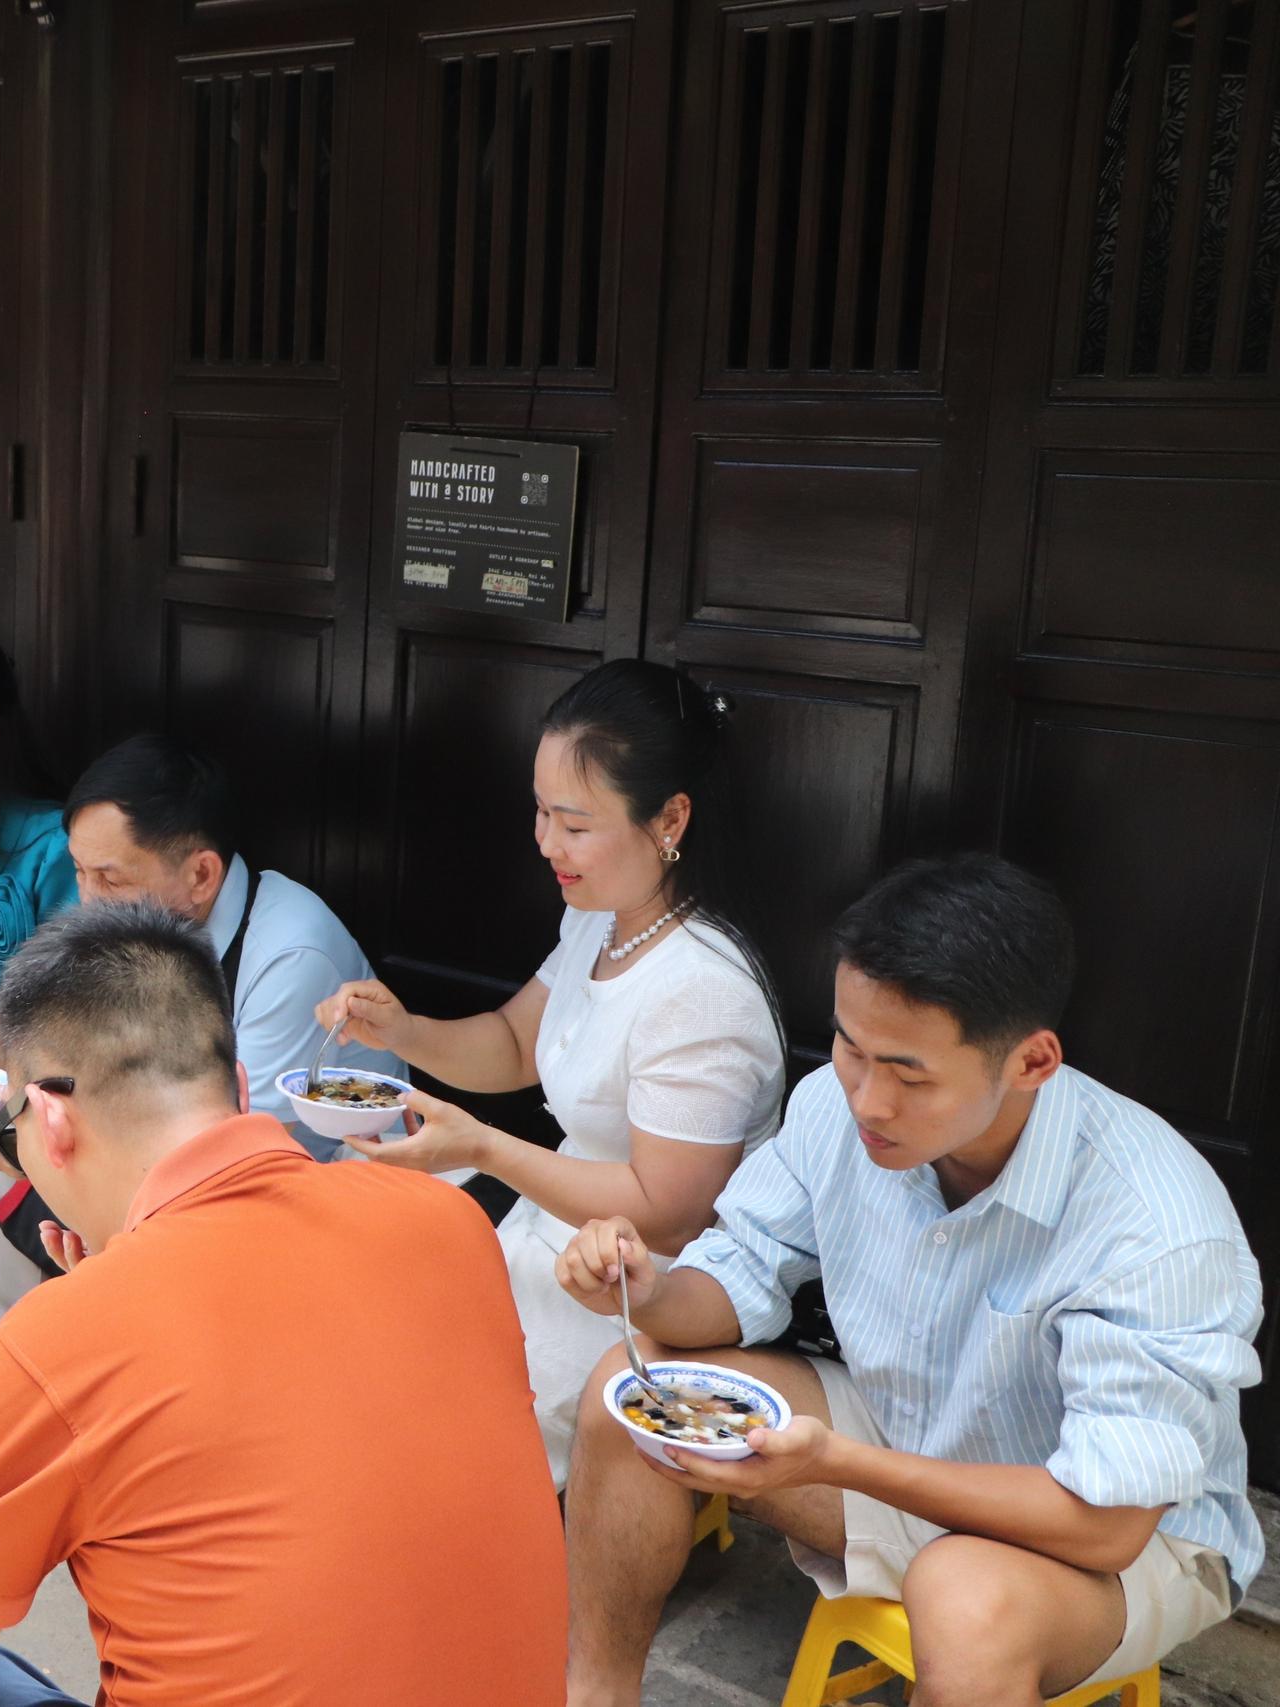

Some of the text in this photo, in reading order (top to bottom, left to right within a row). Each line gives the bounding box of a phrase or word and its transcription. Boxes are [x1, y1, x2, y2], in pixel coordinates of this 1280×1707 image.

[410, 459, 495, 482] HANDCRAFTED
[409, 480, 439, 499] WITH
[457, 485, 494, 505] STORY
